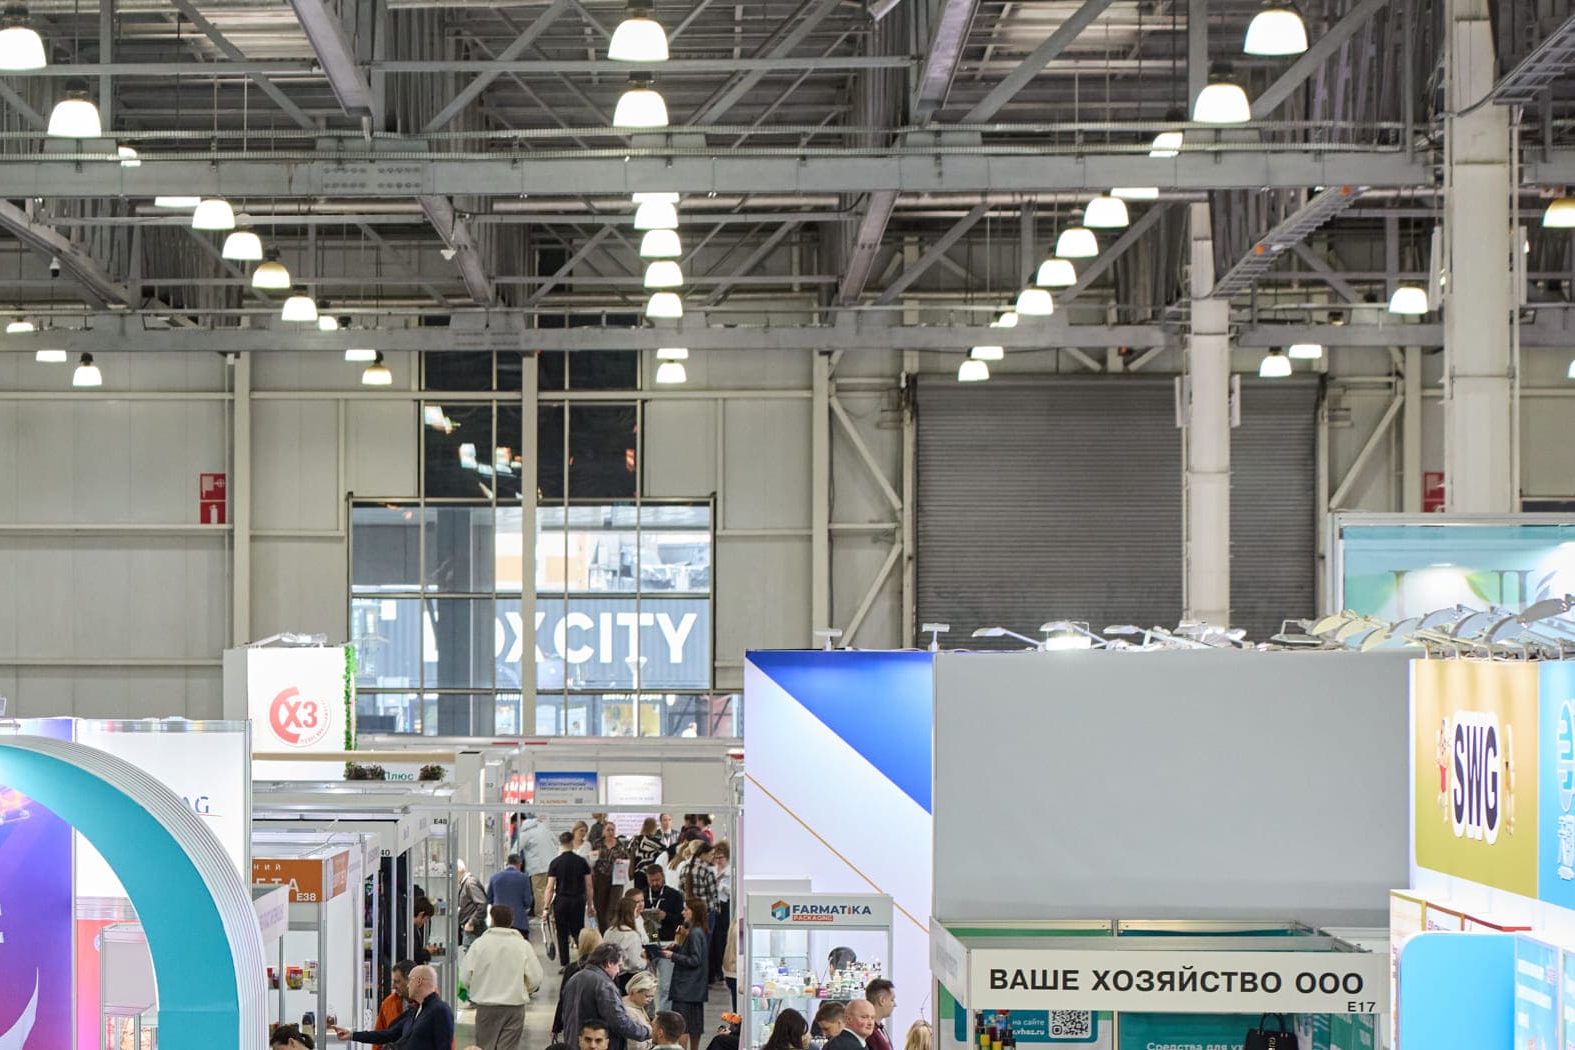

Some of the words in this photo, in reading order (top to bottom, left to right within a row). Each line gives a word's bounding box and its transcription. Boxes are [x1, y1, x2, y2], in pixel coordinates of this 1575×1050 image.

[1453, 723, 1498, 831] SWG
[296, 892, 316, 902] E38
[989, 968, 1080, 991] ВАШЕ
[1092, 965, 1282, 993] ХОЗЯЙСТВО
[1295, 972, 1364, 994] ООО
[1348, 1001, 1376, 1013] E17
